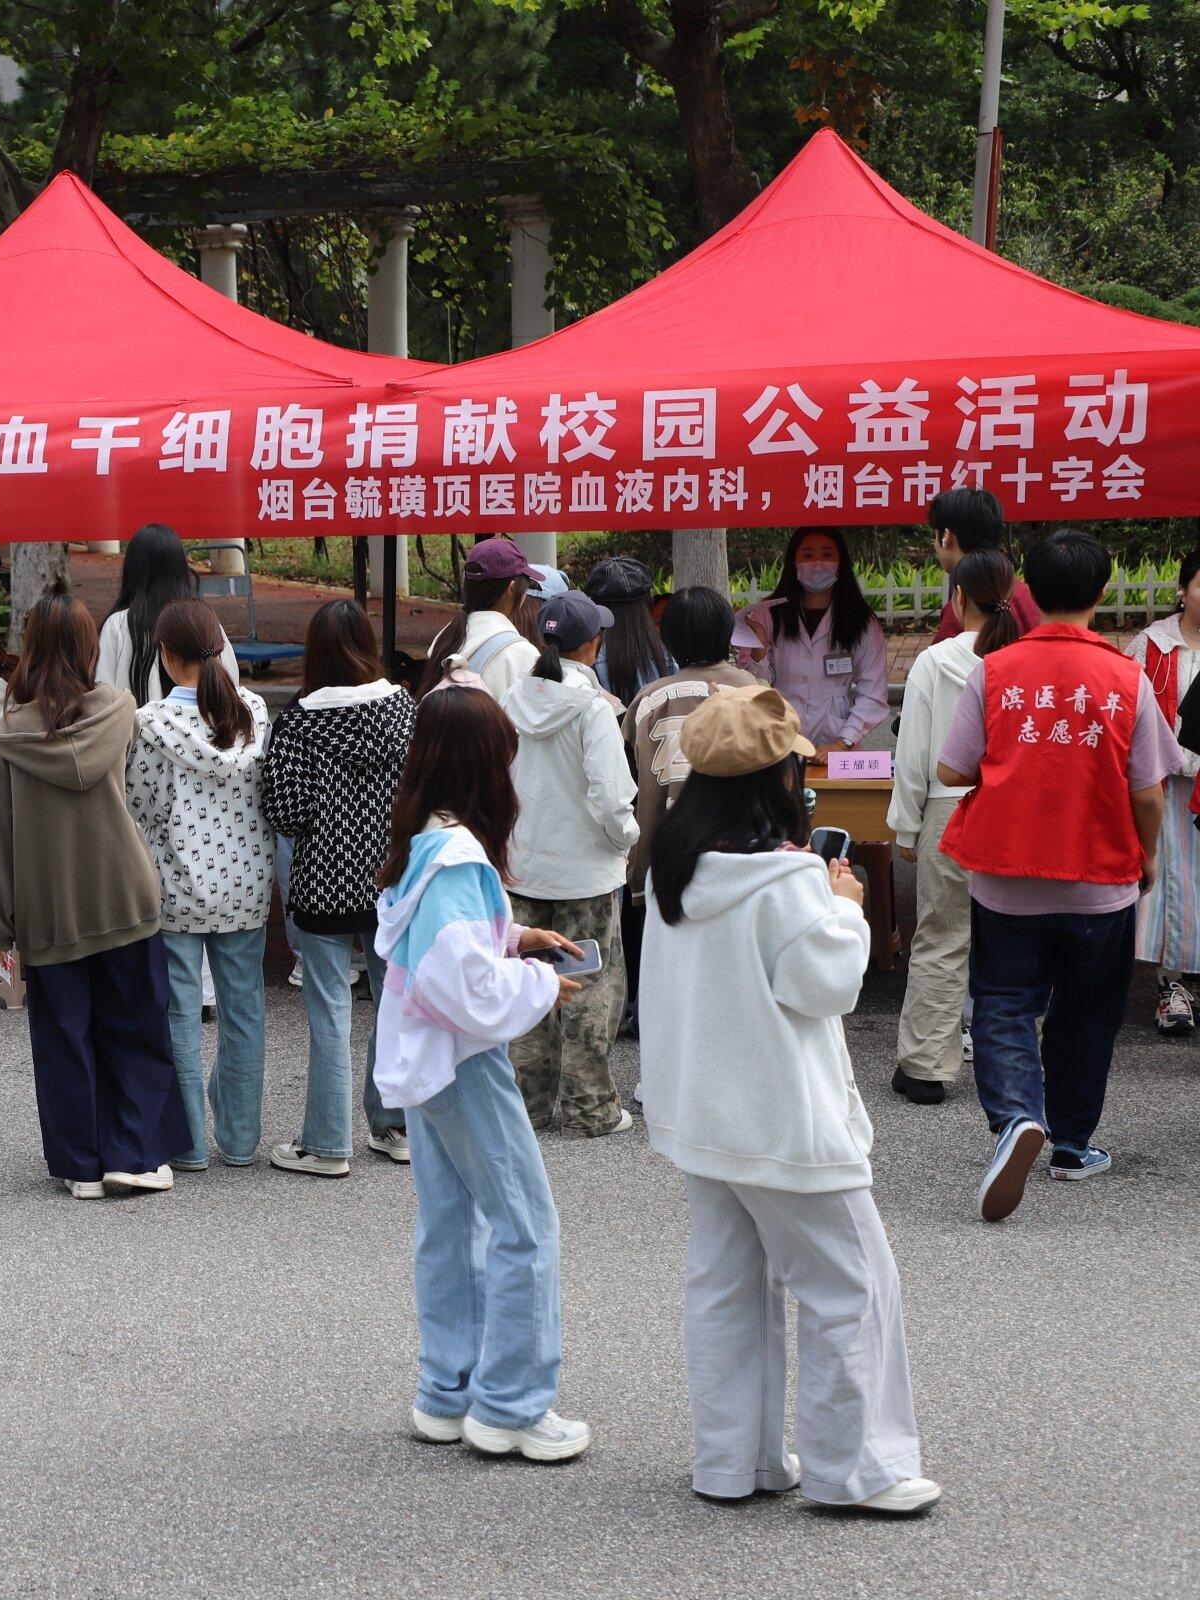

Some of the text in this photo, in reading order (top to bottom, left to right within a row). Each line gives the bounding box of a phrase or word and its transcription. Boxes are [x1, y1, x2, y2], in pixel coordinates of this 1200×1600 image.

[1001, 684, 1124, 720] 滨医青年
[1017, 715, 1104, 749] 志愿者
